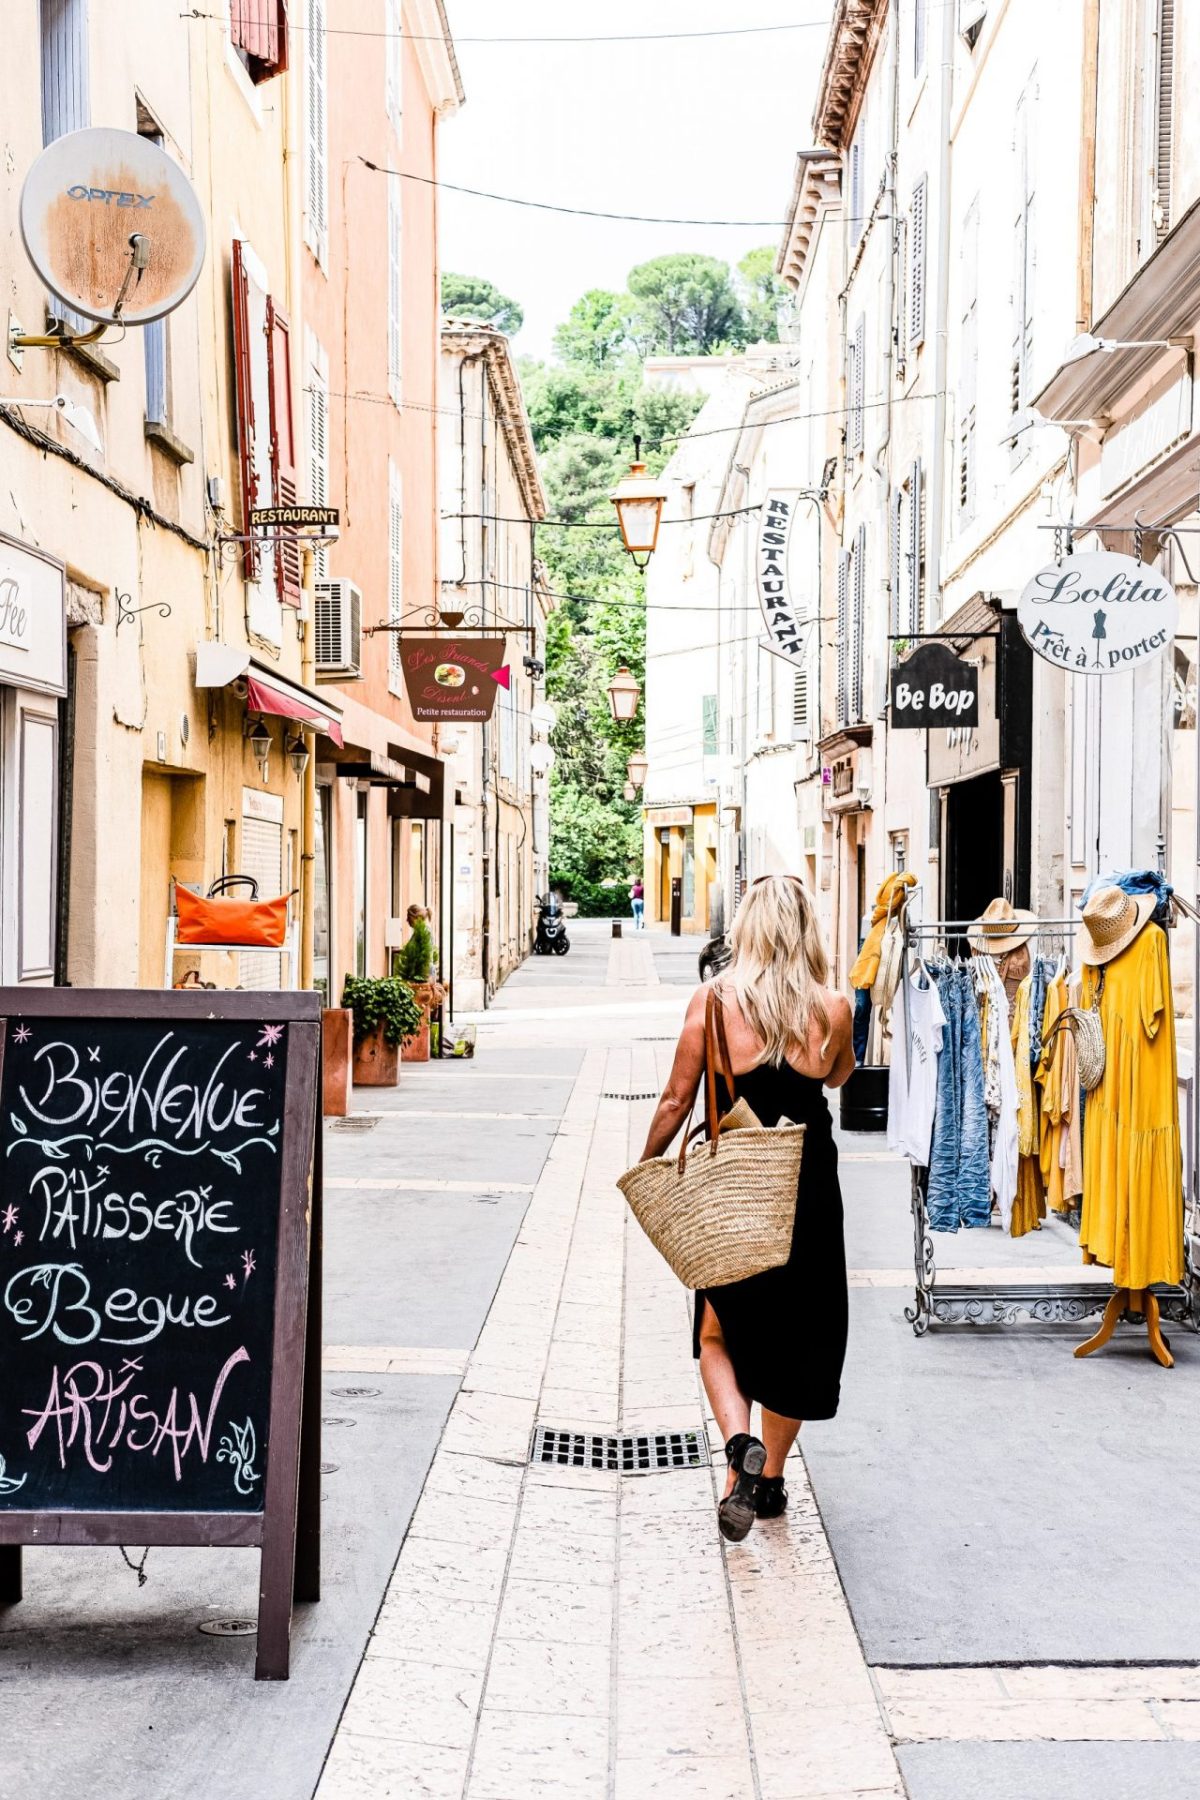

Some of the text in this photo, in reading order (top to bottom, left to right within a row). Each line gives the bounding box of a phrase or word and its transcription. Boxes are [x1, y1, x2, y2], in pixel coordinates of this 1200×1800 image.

[66, 184, 156, 209] OPTEX
[251, 505, 338, 526] RESTAURANT
[761, 499, 805, 655] RESTAURANT
[1031, 571, 1168, 604] Lolita
[1028, 619, 1169, 668] Prêt à porter
[416, 707, 487, 717] Petite restauration
[895, 682, 975, 716] Be Bop
[4, 1262, 232, 1345] Begue
